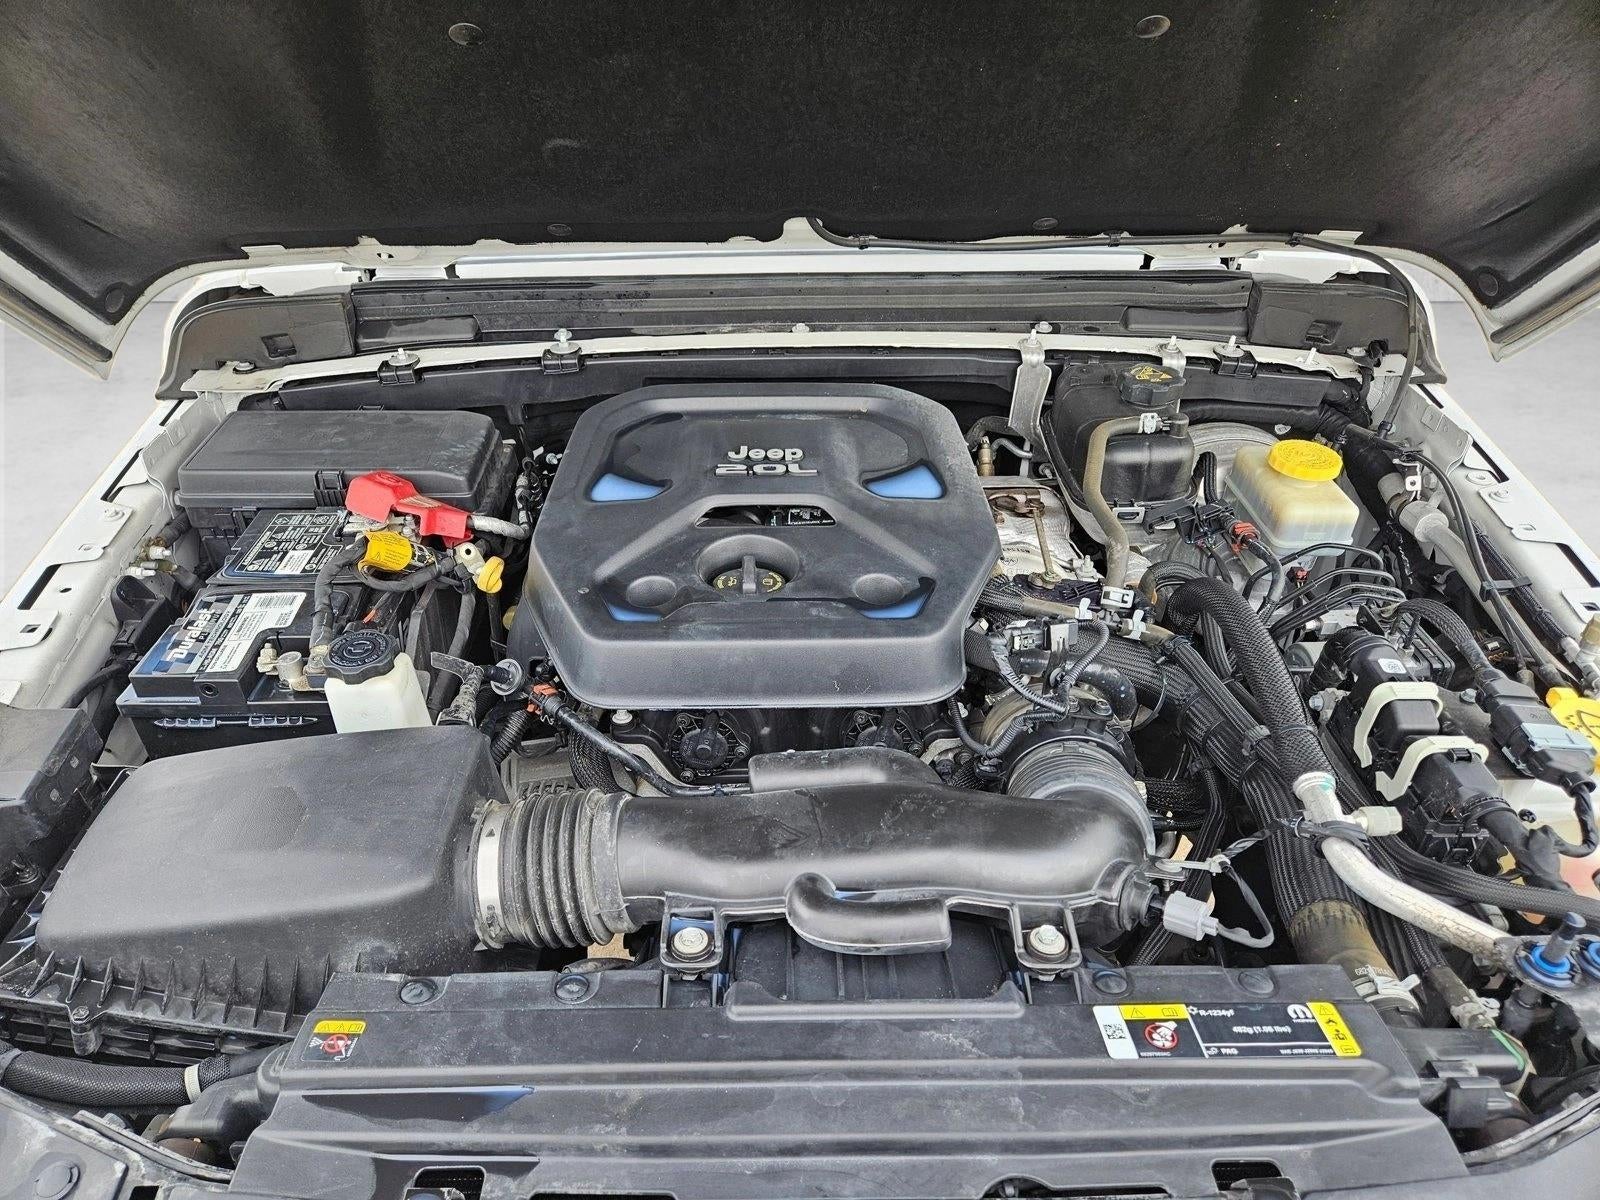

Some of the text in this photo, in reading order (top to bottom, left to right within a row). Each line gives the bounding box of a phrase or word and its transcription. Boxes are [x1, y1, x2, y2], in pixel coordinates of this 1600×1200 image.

[727, 445, 804, 463] Jeep
[715, 464, 818, 476] 2.0L
[167, 607, 216, 661] Duralast
[1200, 1008, 1235, 1018] R-1234yf
